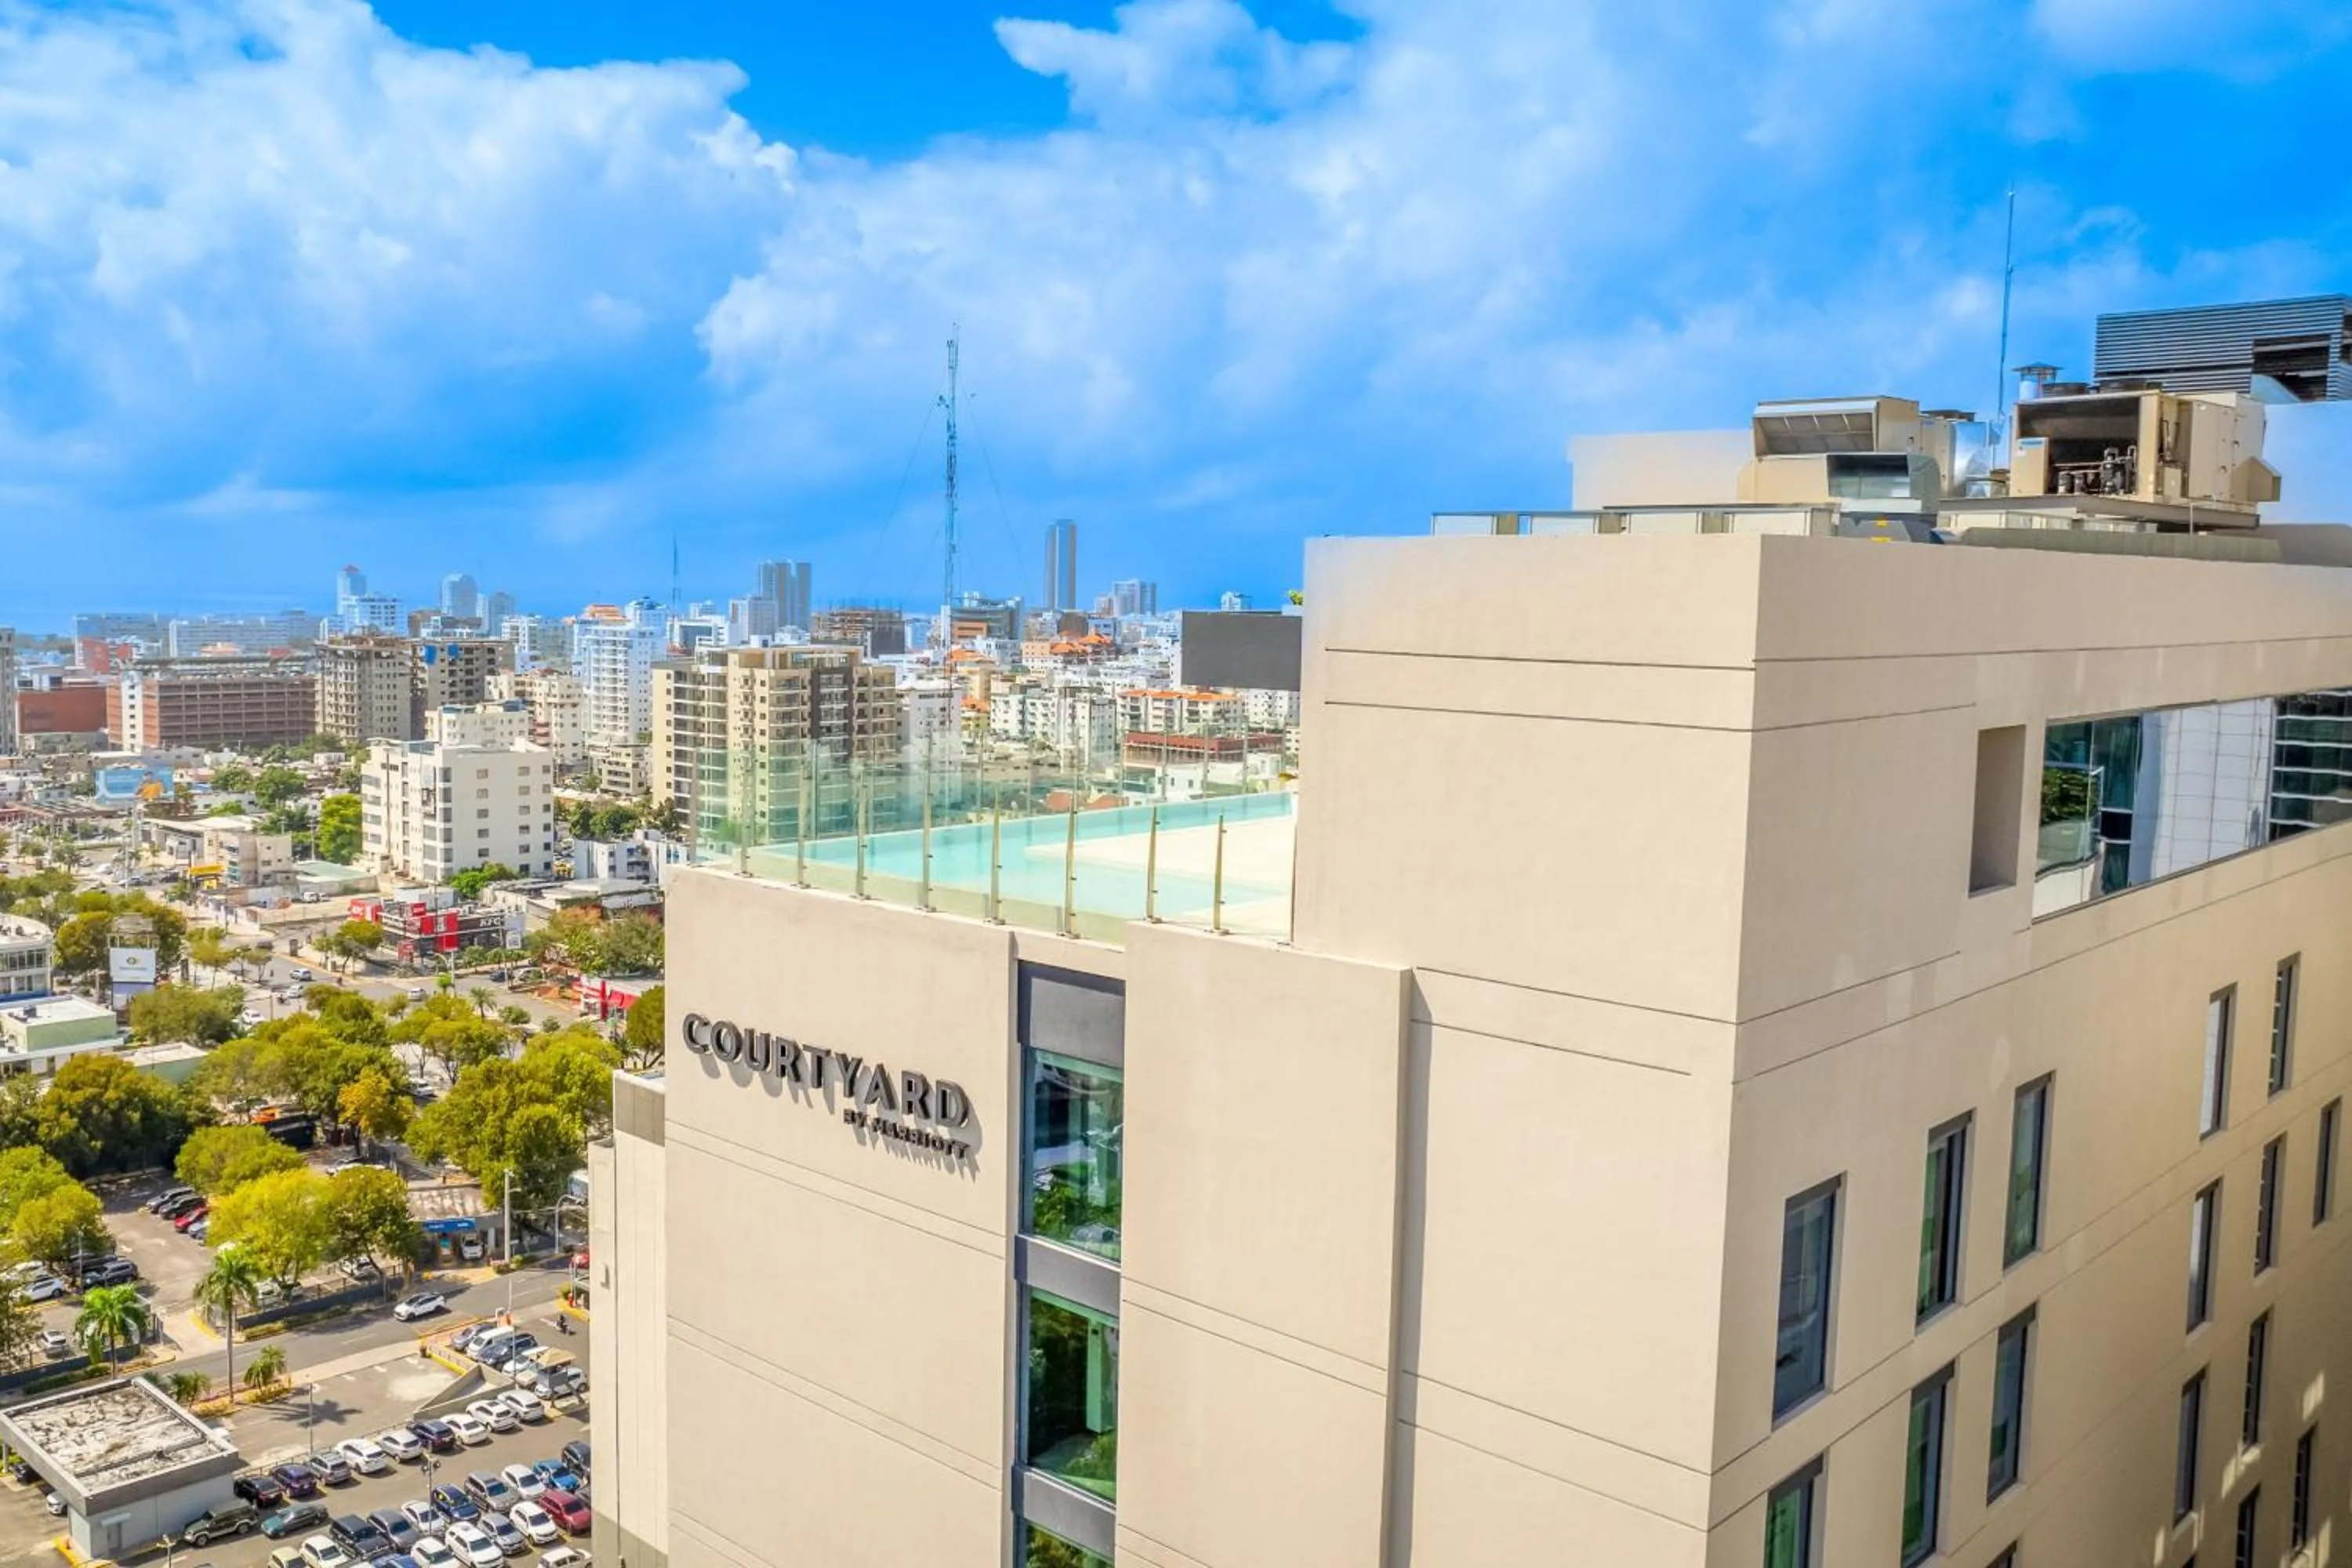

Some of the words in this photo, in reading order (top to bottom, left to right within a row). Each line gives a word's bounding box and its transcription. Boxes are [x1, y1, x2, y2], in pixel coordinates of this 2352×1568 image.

[479, 916, 501, 927] KFC
[682, 1013, 970, 1127] COURTYARD
[844, 1108, 868, 1128] BY
[873, 1117, 970, 1159] MARRIOTT
